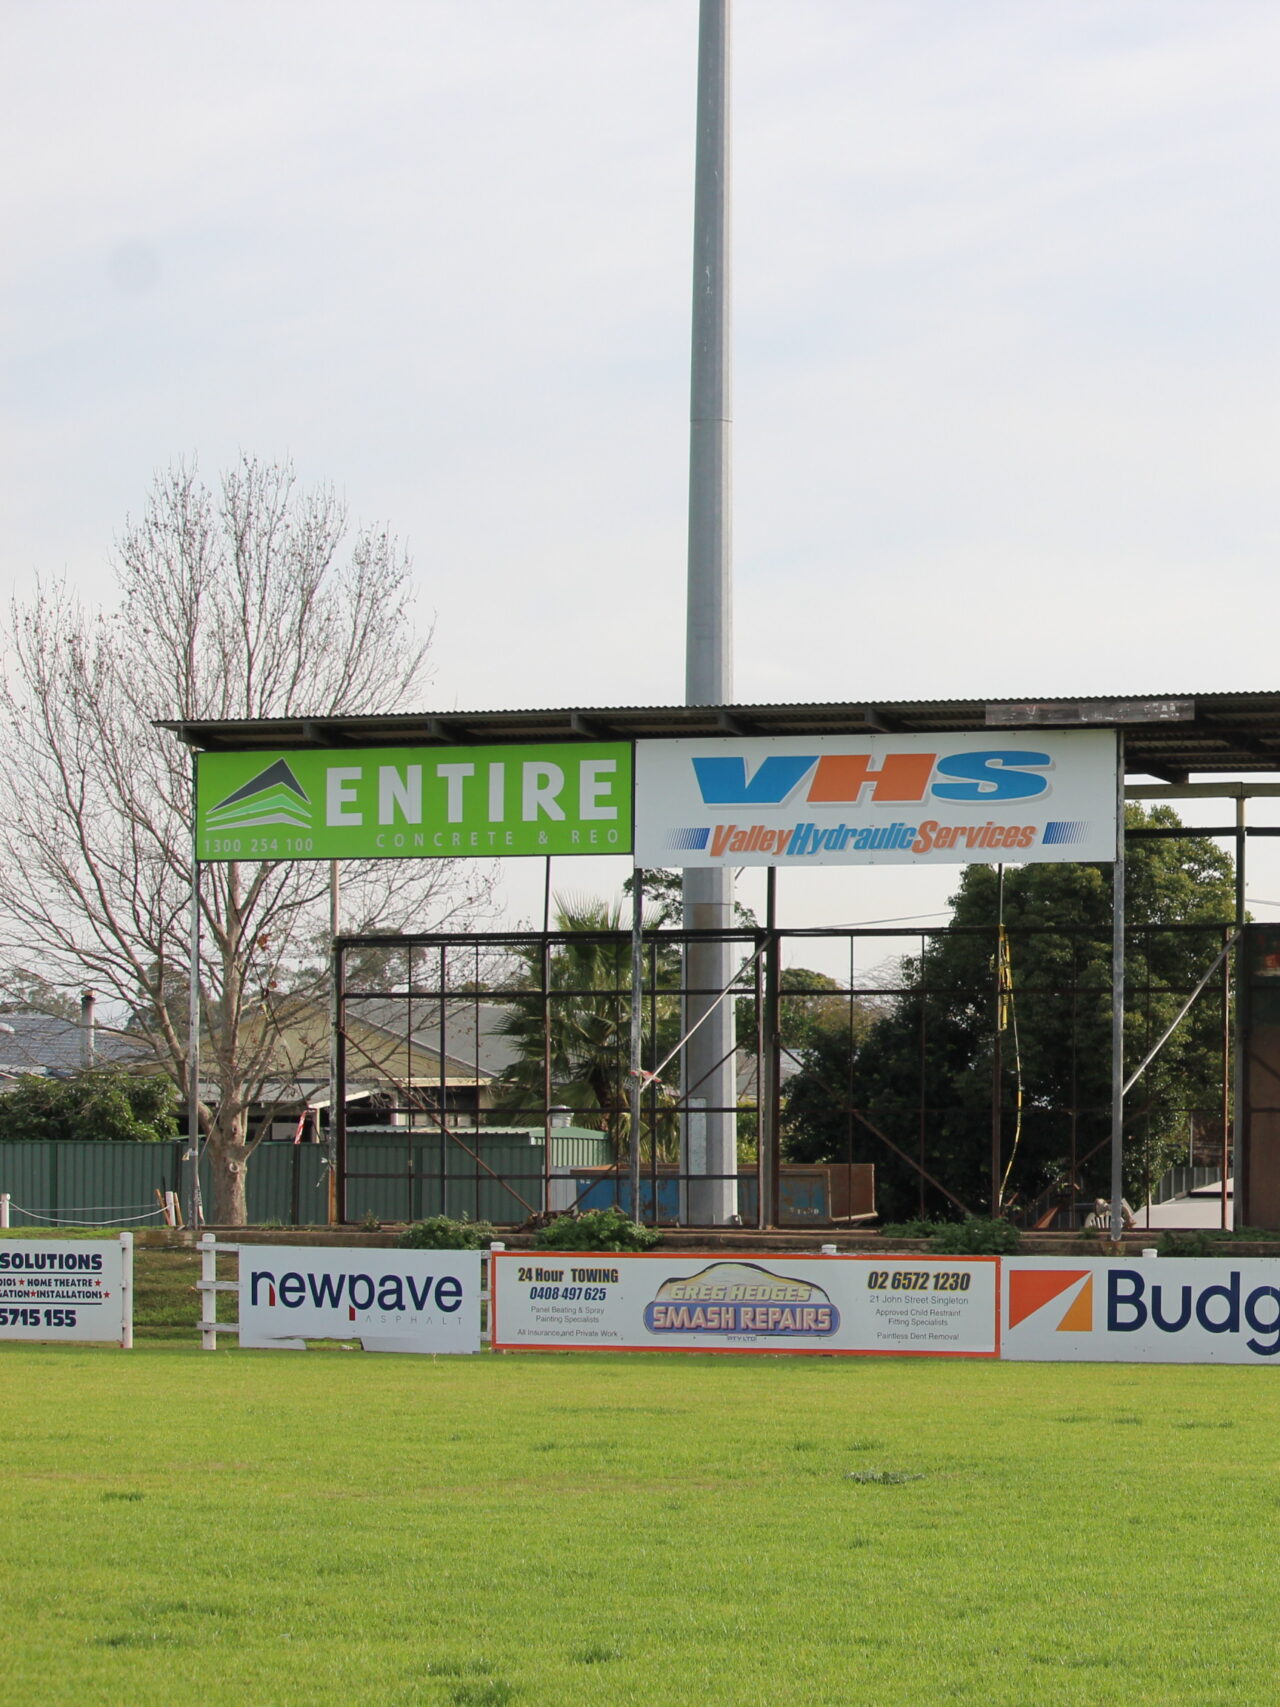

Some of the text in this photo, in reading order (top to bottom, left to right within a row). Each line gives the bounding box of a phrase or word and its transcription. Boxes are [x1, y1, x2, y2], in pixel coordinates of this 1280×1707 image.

[691, 751, 1051, 804] VHS
[326, 760, 618, 827] ENTIRE
[204, 838, 313, 852] 1300 254 100
[376, 830, 618, 847] CONCRETE & REO
[0, 1252, 102, 1270] SOLUTIONS
[518, 1267, 619, 1283] 24 Hour TOWING
[867, 1271, 971, 1291] 02 6572 1230
[28, 1278, 52, 1287] HOME
[54, 1279, 92, 1287] THEATRE
[36, 1290, 102, 1299] INSTALLATIONS
[251, 1272, 463, 1320] newpave
[530, 1286, 607, 1301] 0408 497 625
[670, 1285, 812, 1302] GREG HEDGES
[869, 1295, 968, 1306] 21 John Street Singleton
[552, 1306, 576, 1315] Beating
[585, 1307, 604, 1315] Spray
[876, 1308, 908, 1317] Approved
[44, 1309, 76, 1328] 155
[365, 1314, 463, 1326] ASPHALT
[536, 1315, 600, 1324] Painting Specialists
[653, 1306, 832, 1332] SMASH REPAIRS
[911, 1318, 948, 1327] Specialists
[517, 1328, 526, 1336] All
[877, 1332, 908, 1340] Paintless
[910, 1332, 926, 1340] Dent
